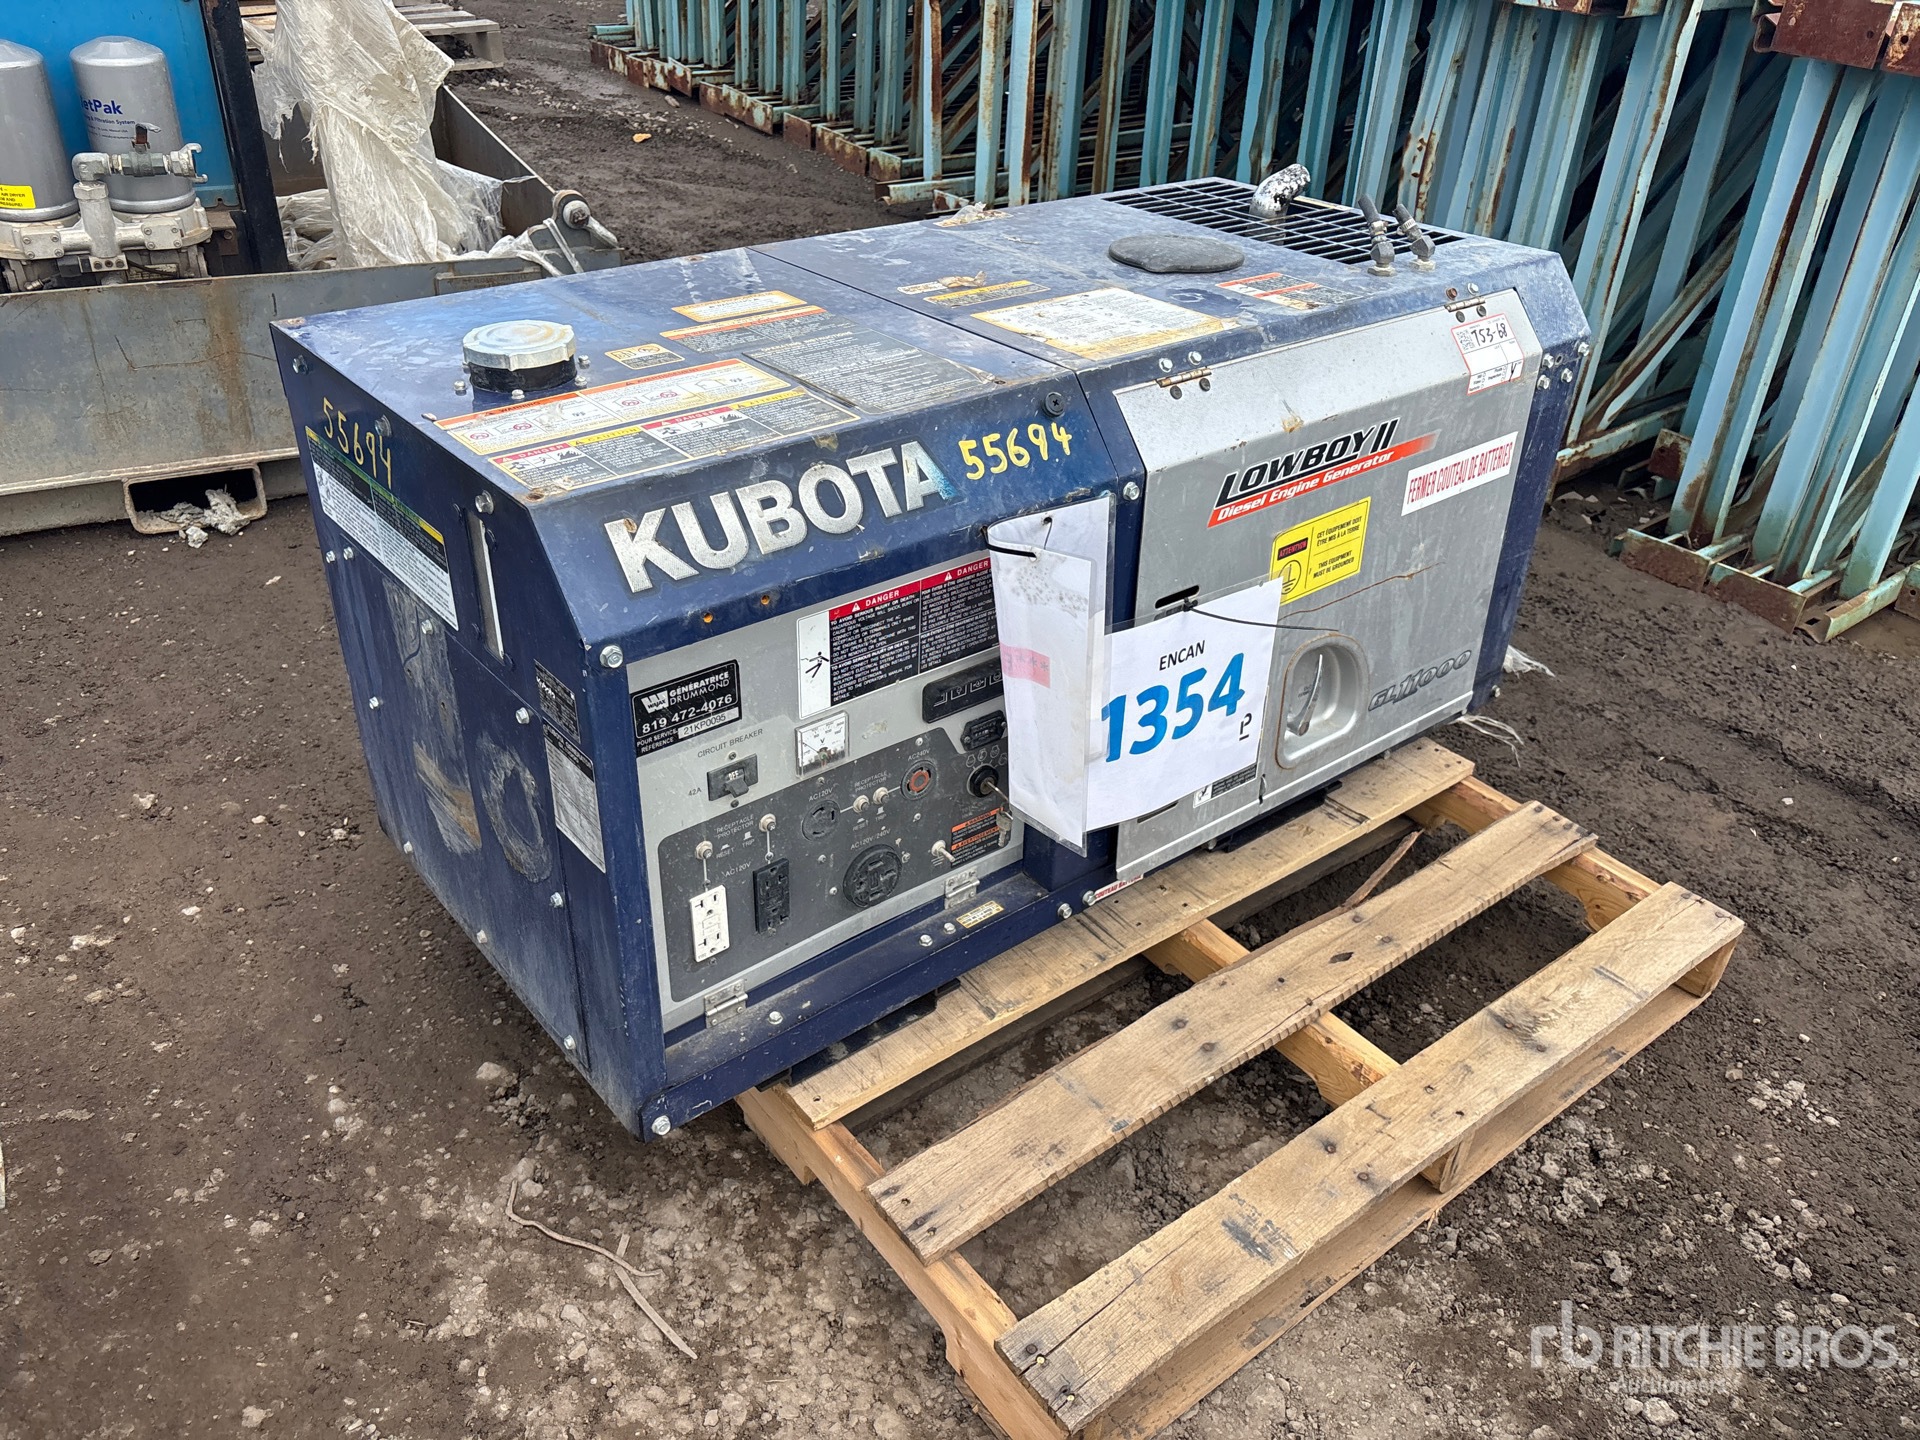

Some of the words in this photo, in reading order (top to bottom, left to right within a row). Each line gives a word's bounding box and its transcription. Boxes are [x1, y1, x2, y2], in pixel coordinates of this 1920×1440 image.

[675, 410, 717, 422] DANGER
[323, 397, 392, 490] 55694
[518, 444, 564, 458] DANGER
[958, 422, 1073, 480] 55694
[1215, 426, 1376, 507] LOWBOY
[1406, 470, 1437, 504] FERMER
[1436, 458, 1470, 493] COUTEAU
[1467, 455, 1479, 481] DE
[1477, 442, 1513, 477] BATTERIES
[1217, 496, 1267, 521] Diesel
[1269, 477, 1320, 503] Engine
[1322, 450, 1395, 484] Generator
[604, 441, 958, 593] KUBOTA
[1317, 531, 1326, 539] CET
[1352, 516, 1362, 525] DOIT
[1328, 535, 1337, 543] MIS
[1347, 525, 1360, 534] TERRE
[1279, 540, 1307, 558] ATTENTION
[957, 560, 988, 576] DANGER
[1313, 569, 1326, 579] MUST
[1326, 566, 1332, 574] BE
[1332, 557, 1355, 572] GROUNDED
[1318, 560, 1328, 569] THIS
[1328, 550, 1352, 564] EQUIPMENT
[865, 589, 899, 606] DANGER
[1159, 640, 1205, 671] ENCAN
[669, 671, 729, 697] GÉNÉRATRICE
[669, 679, 730, 706] DRUMMOND
[642, 717, 667, 733] 819
[671, 694, 733, 722] 472-4076
[1101, 652, 1245, 763] 1354
[683, 713, 726, 736] 21KP0095
[637, 738, 653, 747] POUR
[697, 742, 728, 758] CIRCUIT
[729, 728, 763, 747] BREAKER
[908, 748, 931, 761] AC240V
[728, 770, 740, 780] OFF
[855, 776, 887, 792] PROTECTOR
[688, 787, 702, 796] 42A
[809, 787, 833, 801] AC120V
[716, 814, 754, 834] RECEPTACLE
[717, 821, 754, 839] PROTECTOR
[716, 848, 735, 858] RESET
[742, 839, 755, 848] TRIP
[724, 861, 752, 877] AC120V
